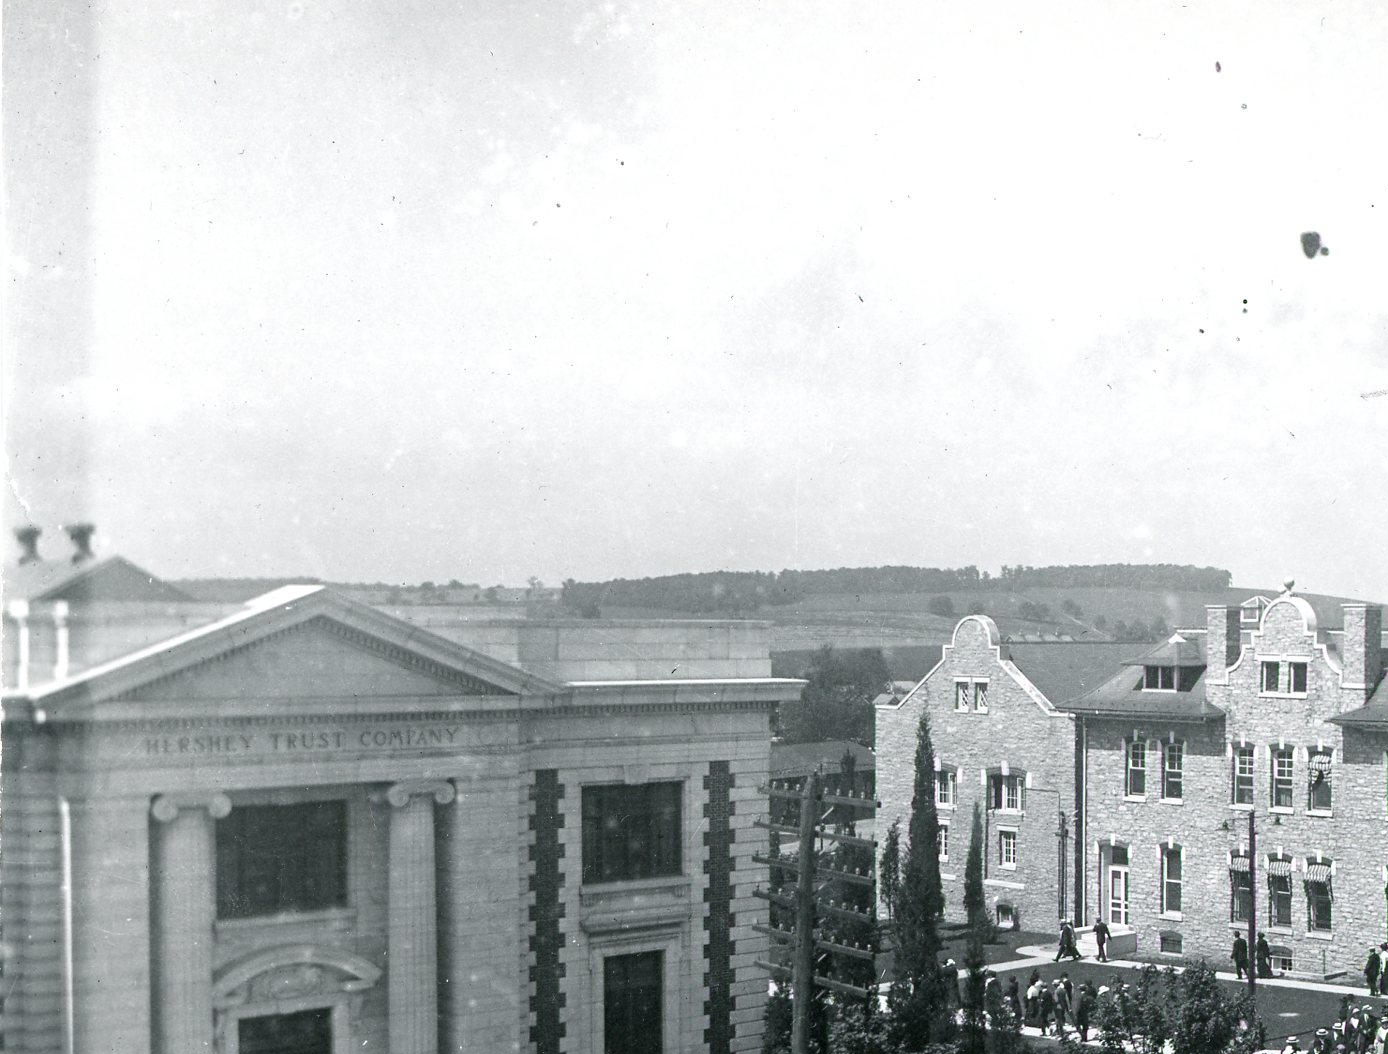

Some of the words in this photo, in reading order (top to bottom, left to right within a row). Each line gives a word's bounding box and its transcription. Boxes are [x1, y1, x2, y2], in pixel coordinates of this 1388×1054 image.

[146, 733, 254, 753] HERSHEY
[268, 730, 346, 750] TRUST
[359, 726, 460, 746] COMPANY
